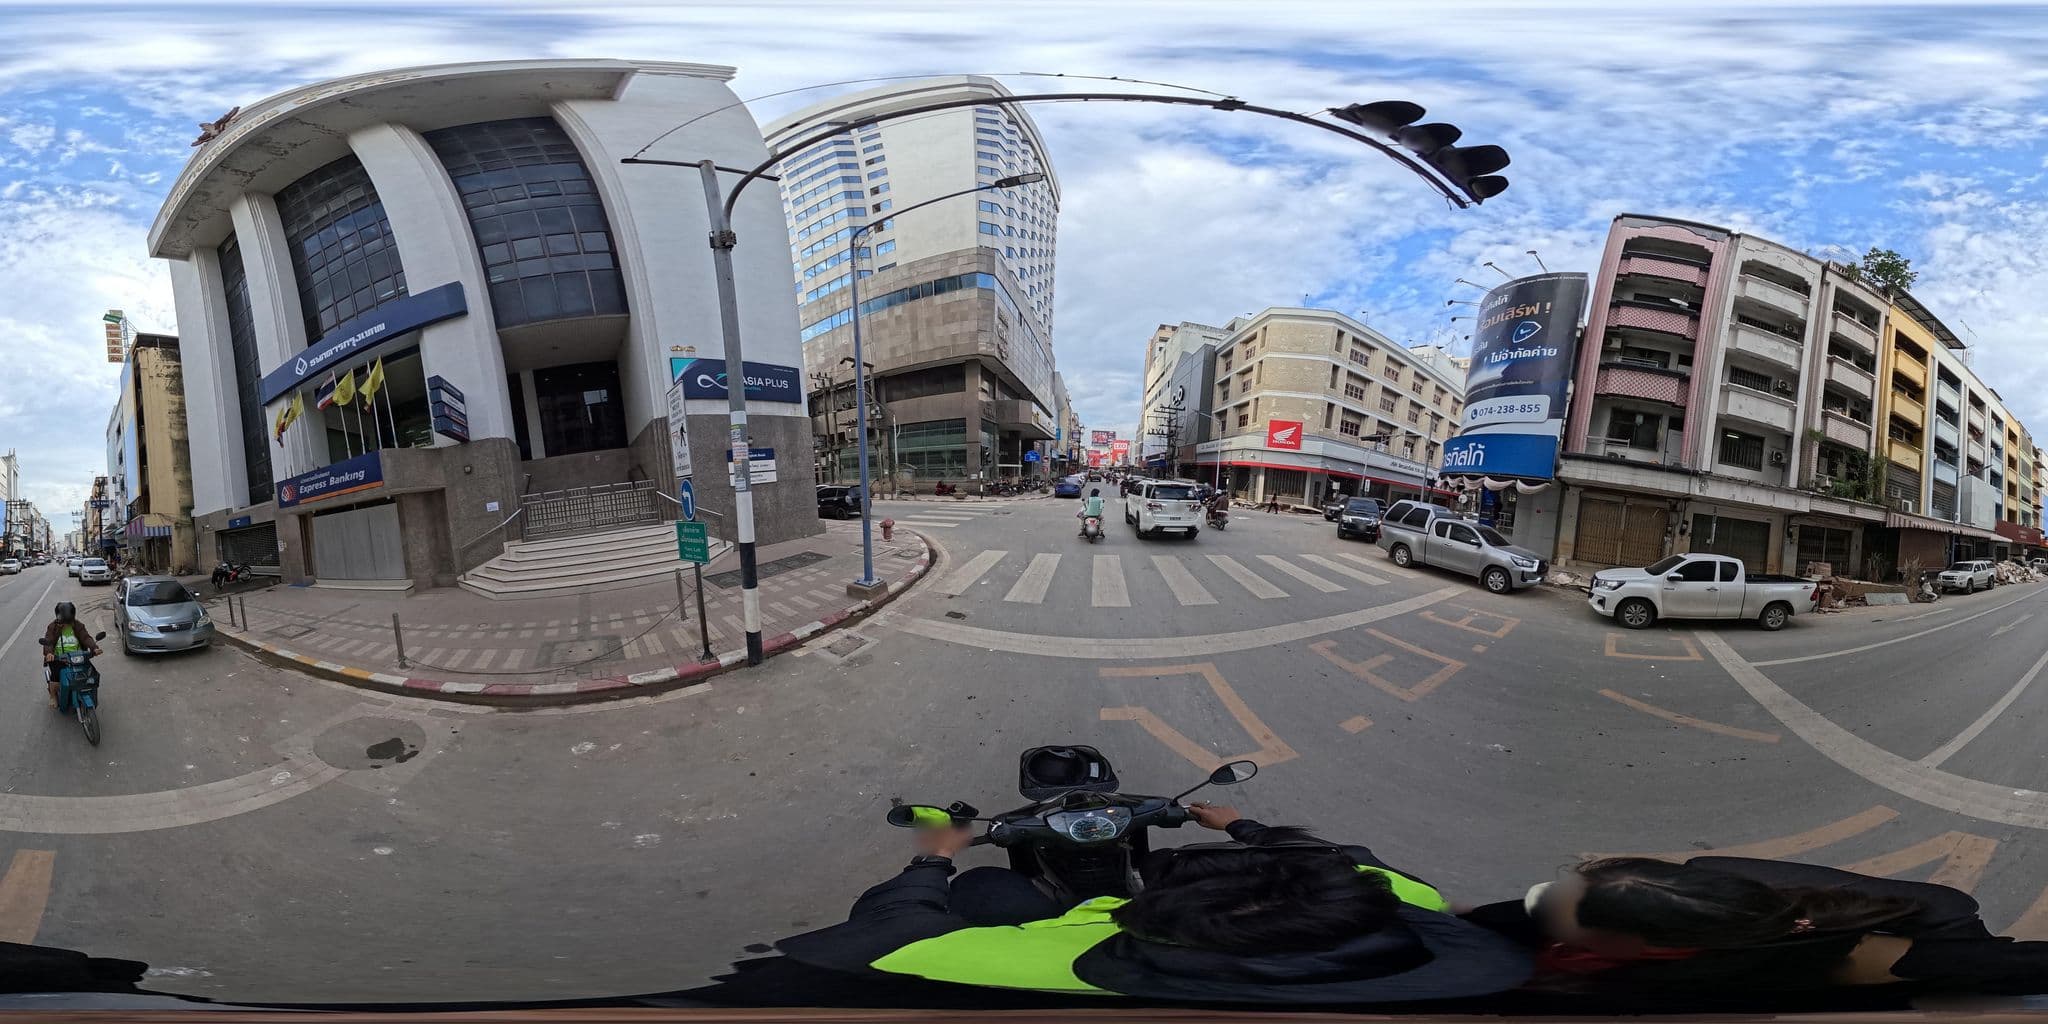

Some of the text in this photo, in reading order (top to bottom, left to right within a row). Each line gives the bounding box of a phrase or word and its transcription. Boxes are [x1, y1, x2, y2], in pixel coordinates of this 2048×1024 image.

[765, 378, 789, 389] PLUS
[1478, 404, 1541, 417] 074-238-855
[299, 479, 327, 495] Express
[329, 469, 365, 486] Banking
